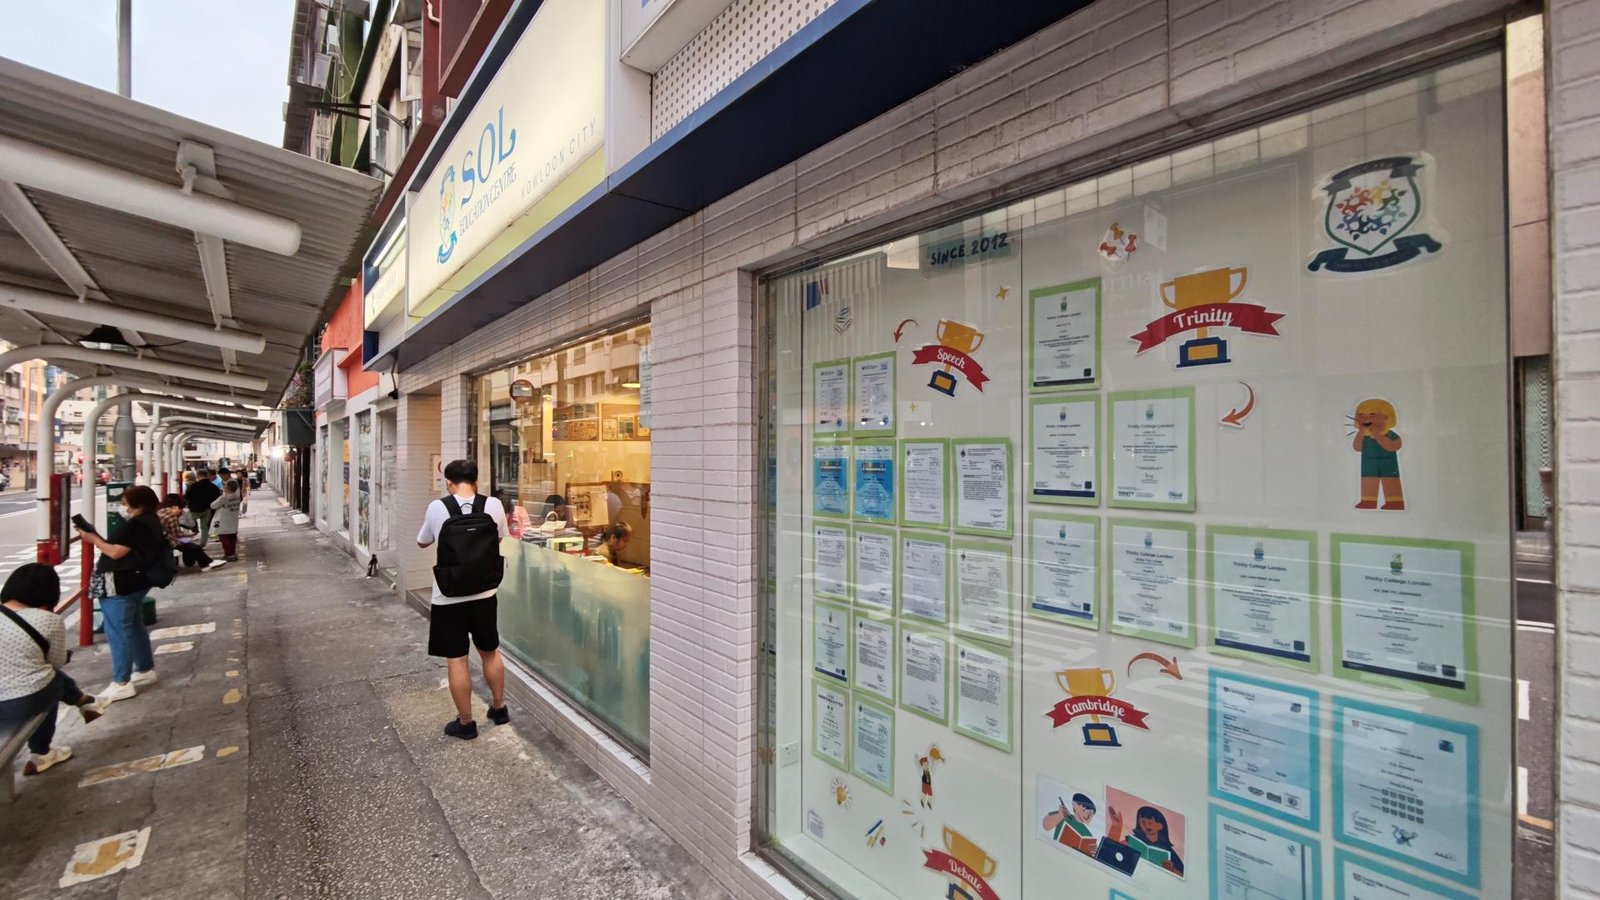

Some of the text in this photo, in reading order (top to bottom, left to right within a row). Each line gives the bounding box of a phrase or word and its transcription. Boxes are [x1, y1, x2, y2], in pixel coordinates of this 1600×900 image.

[461, 104, 517, 208] SOL
[521, 117, 597, 200] KOWLOON CITY
[930, 233, 1009, 266] SINCE 2012
[1172, 307, 1235, 329] Trinity
[937, 348, 967, 370] Speech
[1064, 698, 1126, 718] Cambridge
[948, 858, 983, 893] Debate
